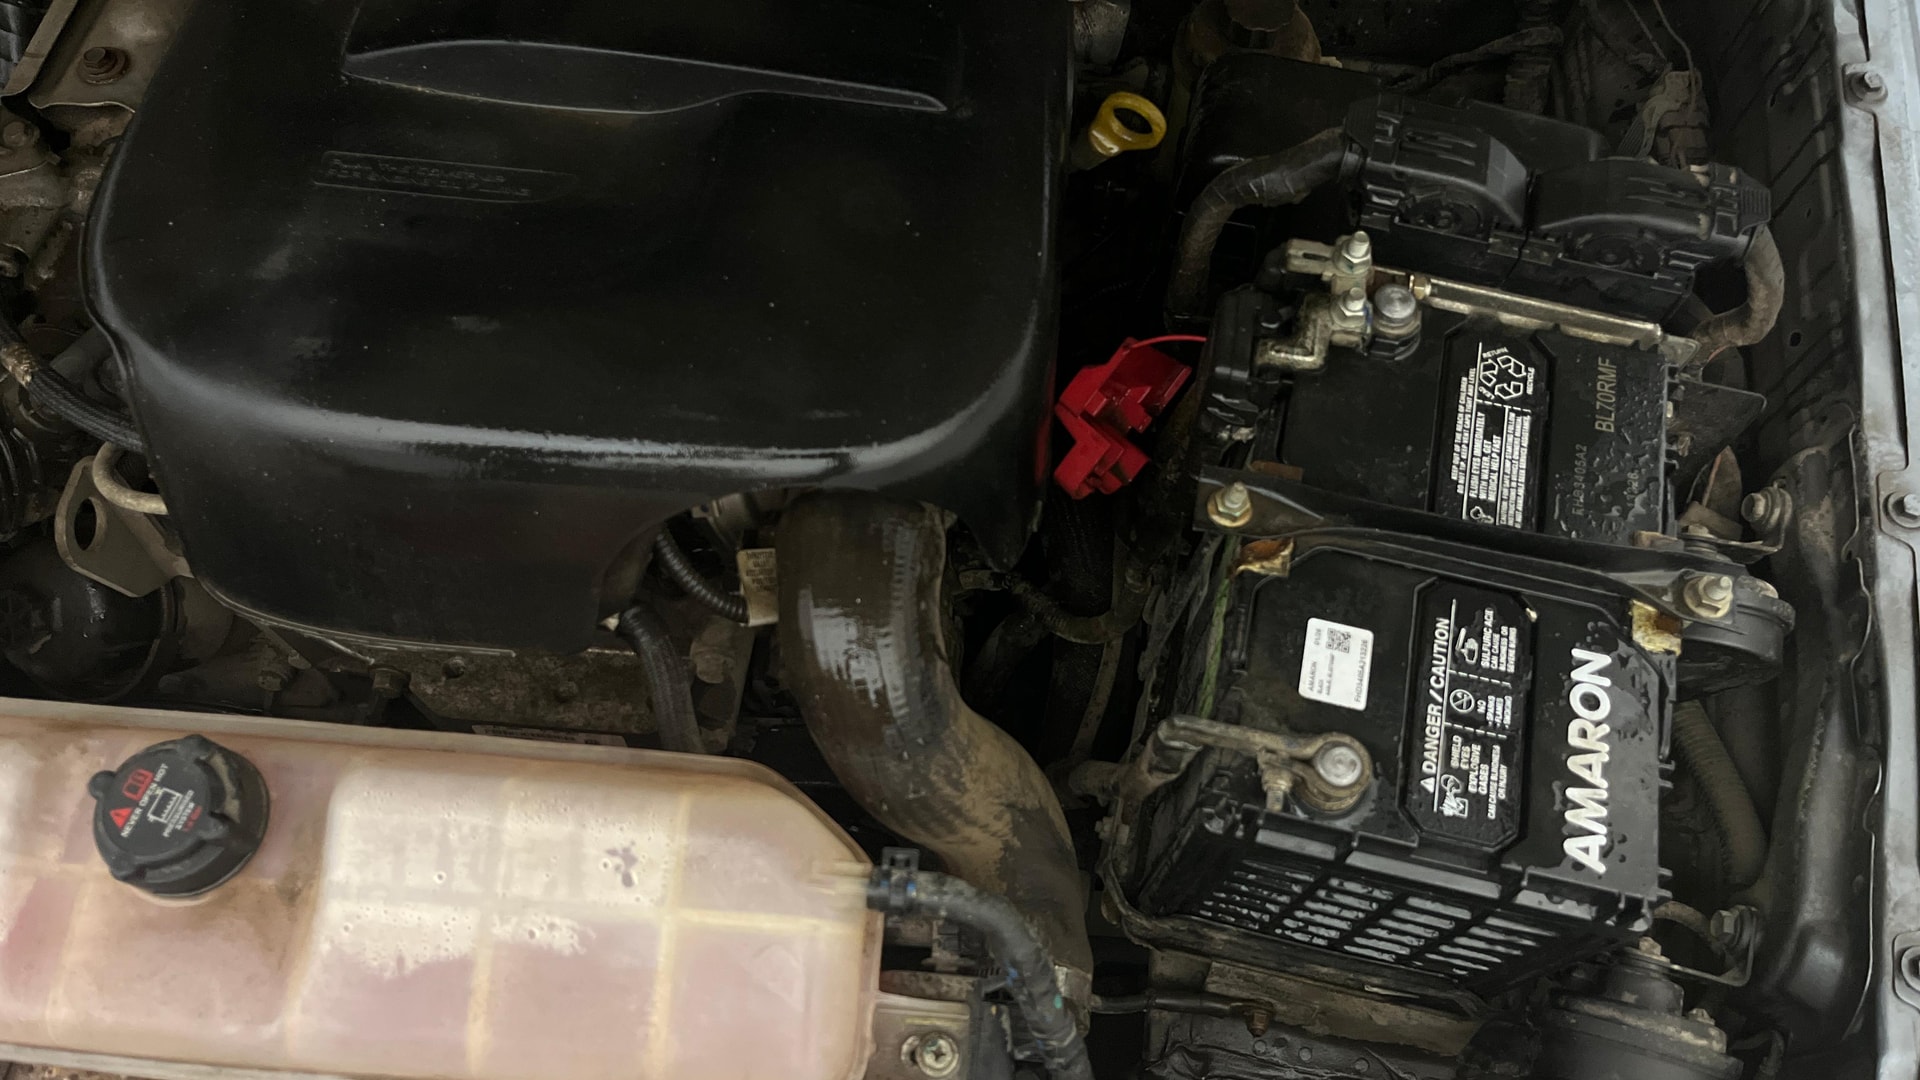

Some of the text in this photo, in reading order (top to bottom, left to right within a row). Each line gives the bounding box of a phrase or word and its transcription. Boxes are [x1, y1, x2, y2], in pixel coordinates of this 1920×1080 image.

[1459, 377, 1467, 404] CHILDREN
[1526, 367, 1535, 395] RECYCLE
[1595, 356, 1617, 432] BL70RMF
[1454, 432, 1462, 443] THE
[1456, 413, 1464, 432] REACH
[1507, 412, 1515, 433] FOLLOW
[1452, 453, 1460, 464] OUT
[1469, 412, 1485, 497] FLUSH EYES IMMEDIATELY
[1483, 440, 1492, 453] GET
[1505, 434, 1513, 459] STARTING
[1488, 435, 1501, 501] MEDICAL HELP FAST
[1457, 484, 1464, 494] DO
[1479, 481, 1488, 499] WITH
[1430, 617, 1449, 689] CAUTION
[1481, 627, 1492, 668] SULFURIC
[1491, 633, 1500, 669] CAN CAUSE
[1499, 626, 1509, 671] BLINDNESS OR
[1308, 661, 1317, 691] AMARON
[1477, 699, 1487, 713] NO
[1422, 704, 1442, 774] DANGER
[1450, 735, 1461, 769] SHIELD
[1460, 746, 1470, 770] EYES
[1468, 744, 1481, 794] EXPLOSIVE
[1562, 648, 1612, 874] AMARON
[1479, 764, 1489, 795] GASES
[1489, 782, 1498, 803] CAUSE
[1498, 764, 1507, 799] OR INJURY
[121, 763, 168, 837] NEVER OPEN HOT
[1488, 803, 1496, 819] CAN
